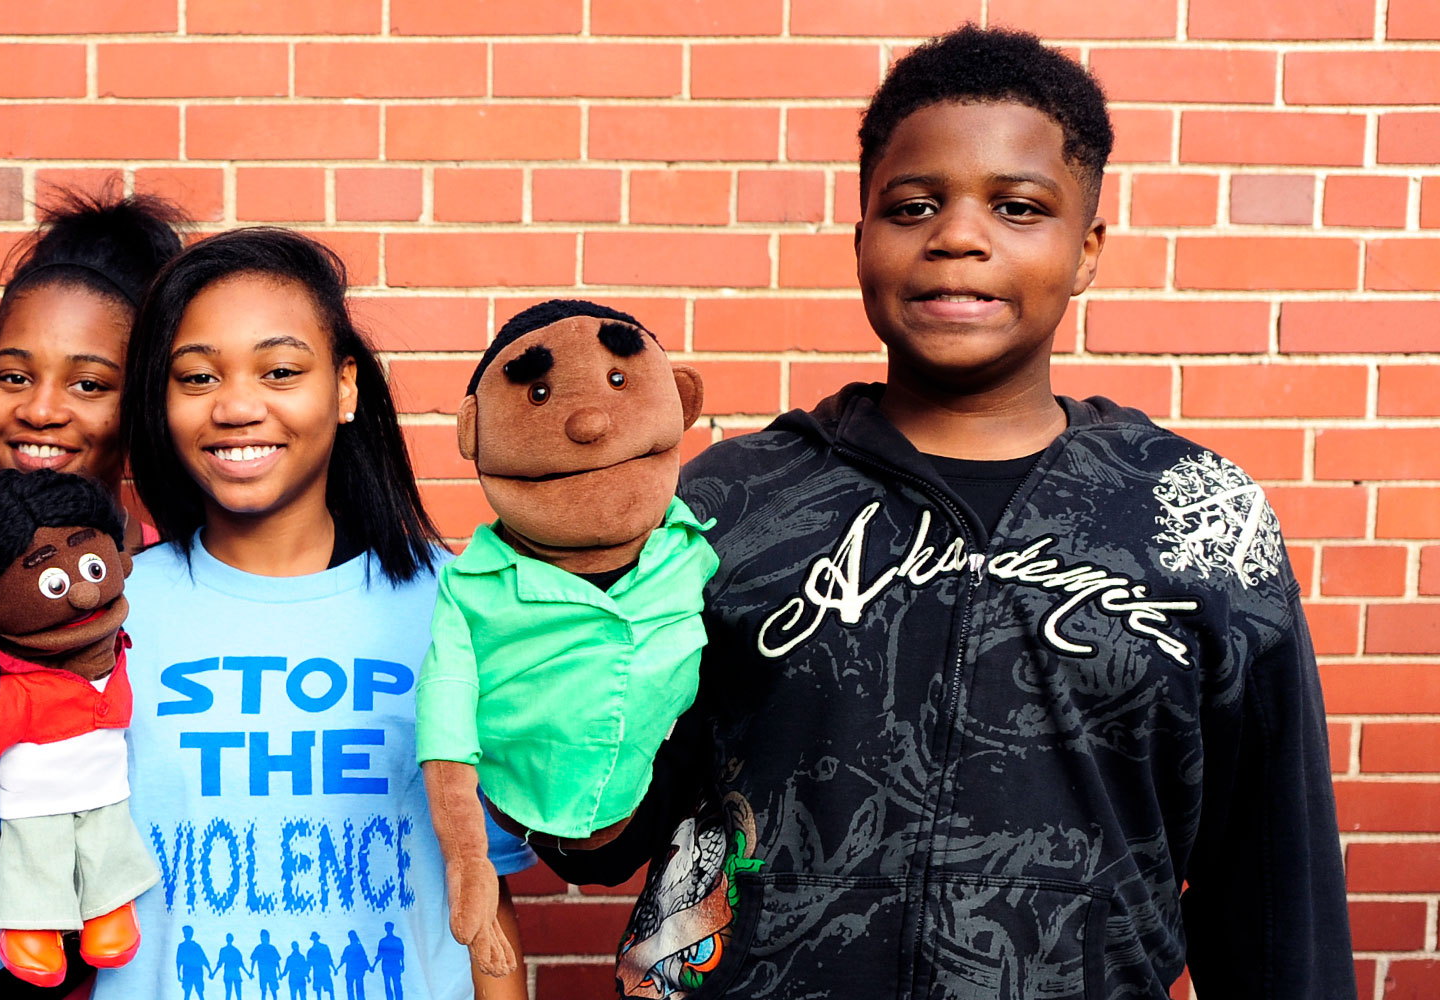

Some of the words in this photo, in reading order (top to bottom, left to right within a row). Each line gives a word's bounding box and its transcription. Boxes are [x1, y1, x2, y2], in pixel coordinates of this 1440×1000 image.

[156, 656, 414, 717] STOP
[180, 729, 389, 797] THE
[149, 814, 415, 916] VIOLENCE
